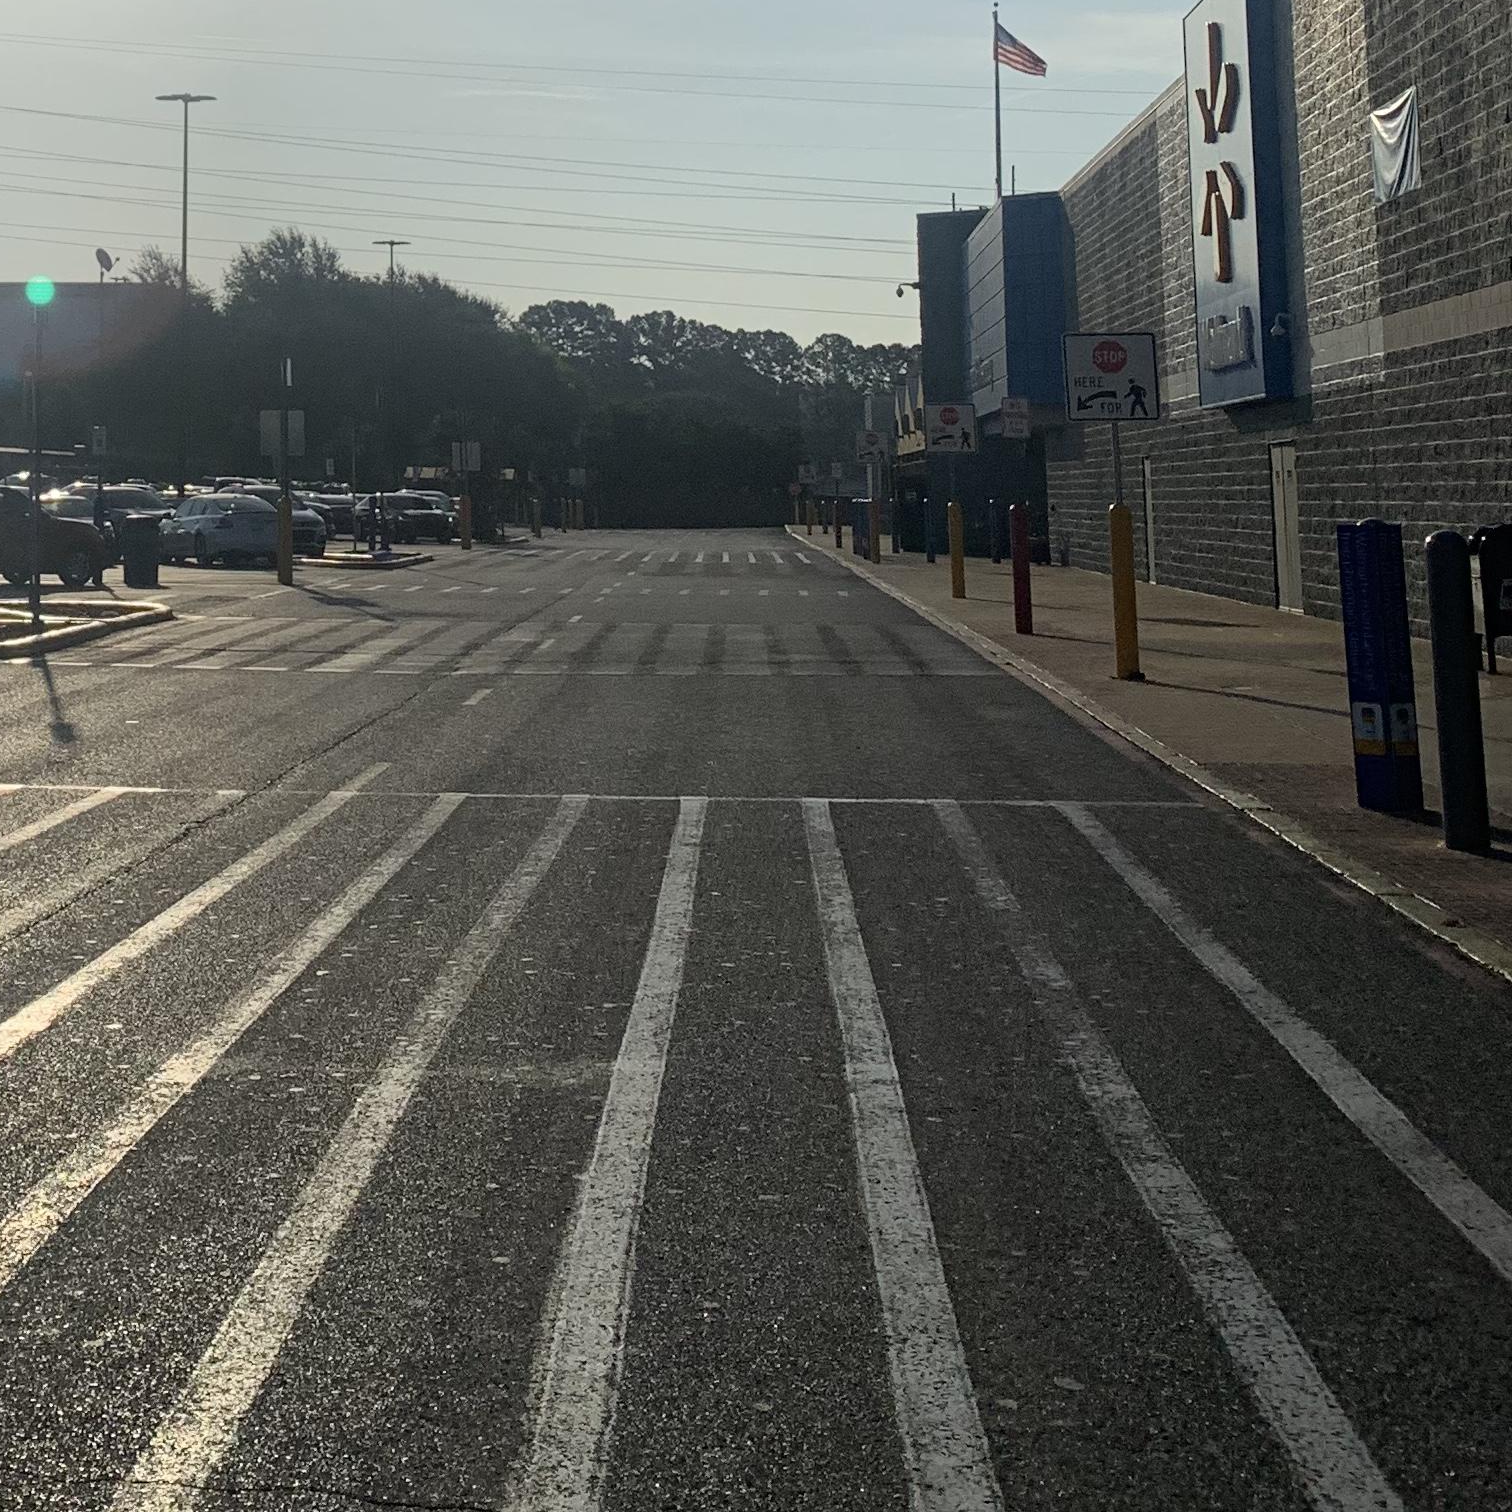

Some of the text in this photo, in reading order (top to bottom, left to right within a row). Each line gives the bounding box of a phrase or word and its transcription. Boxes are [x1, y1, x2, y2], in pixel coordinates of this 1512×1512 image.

[1094, 349, 1126, 364] STOP
[1074, 376, 1104, 388] HERE
[1100, 402, 1122, 414] FOR
